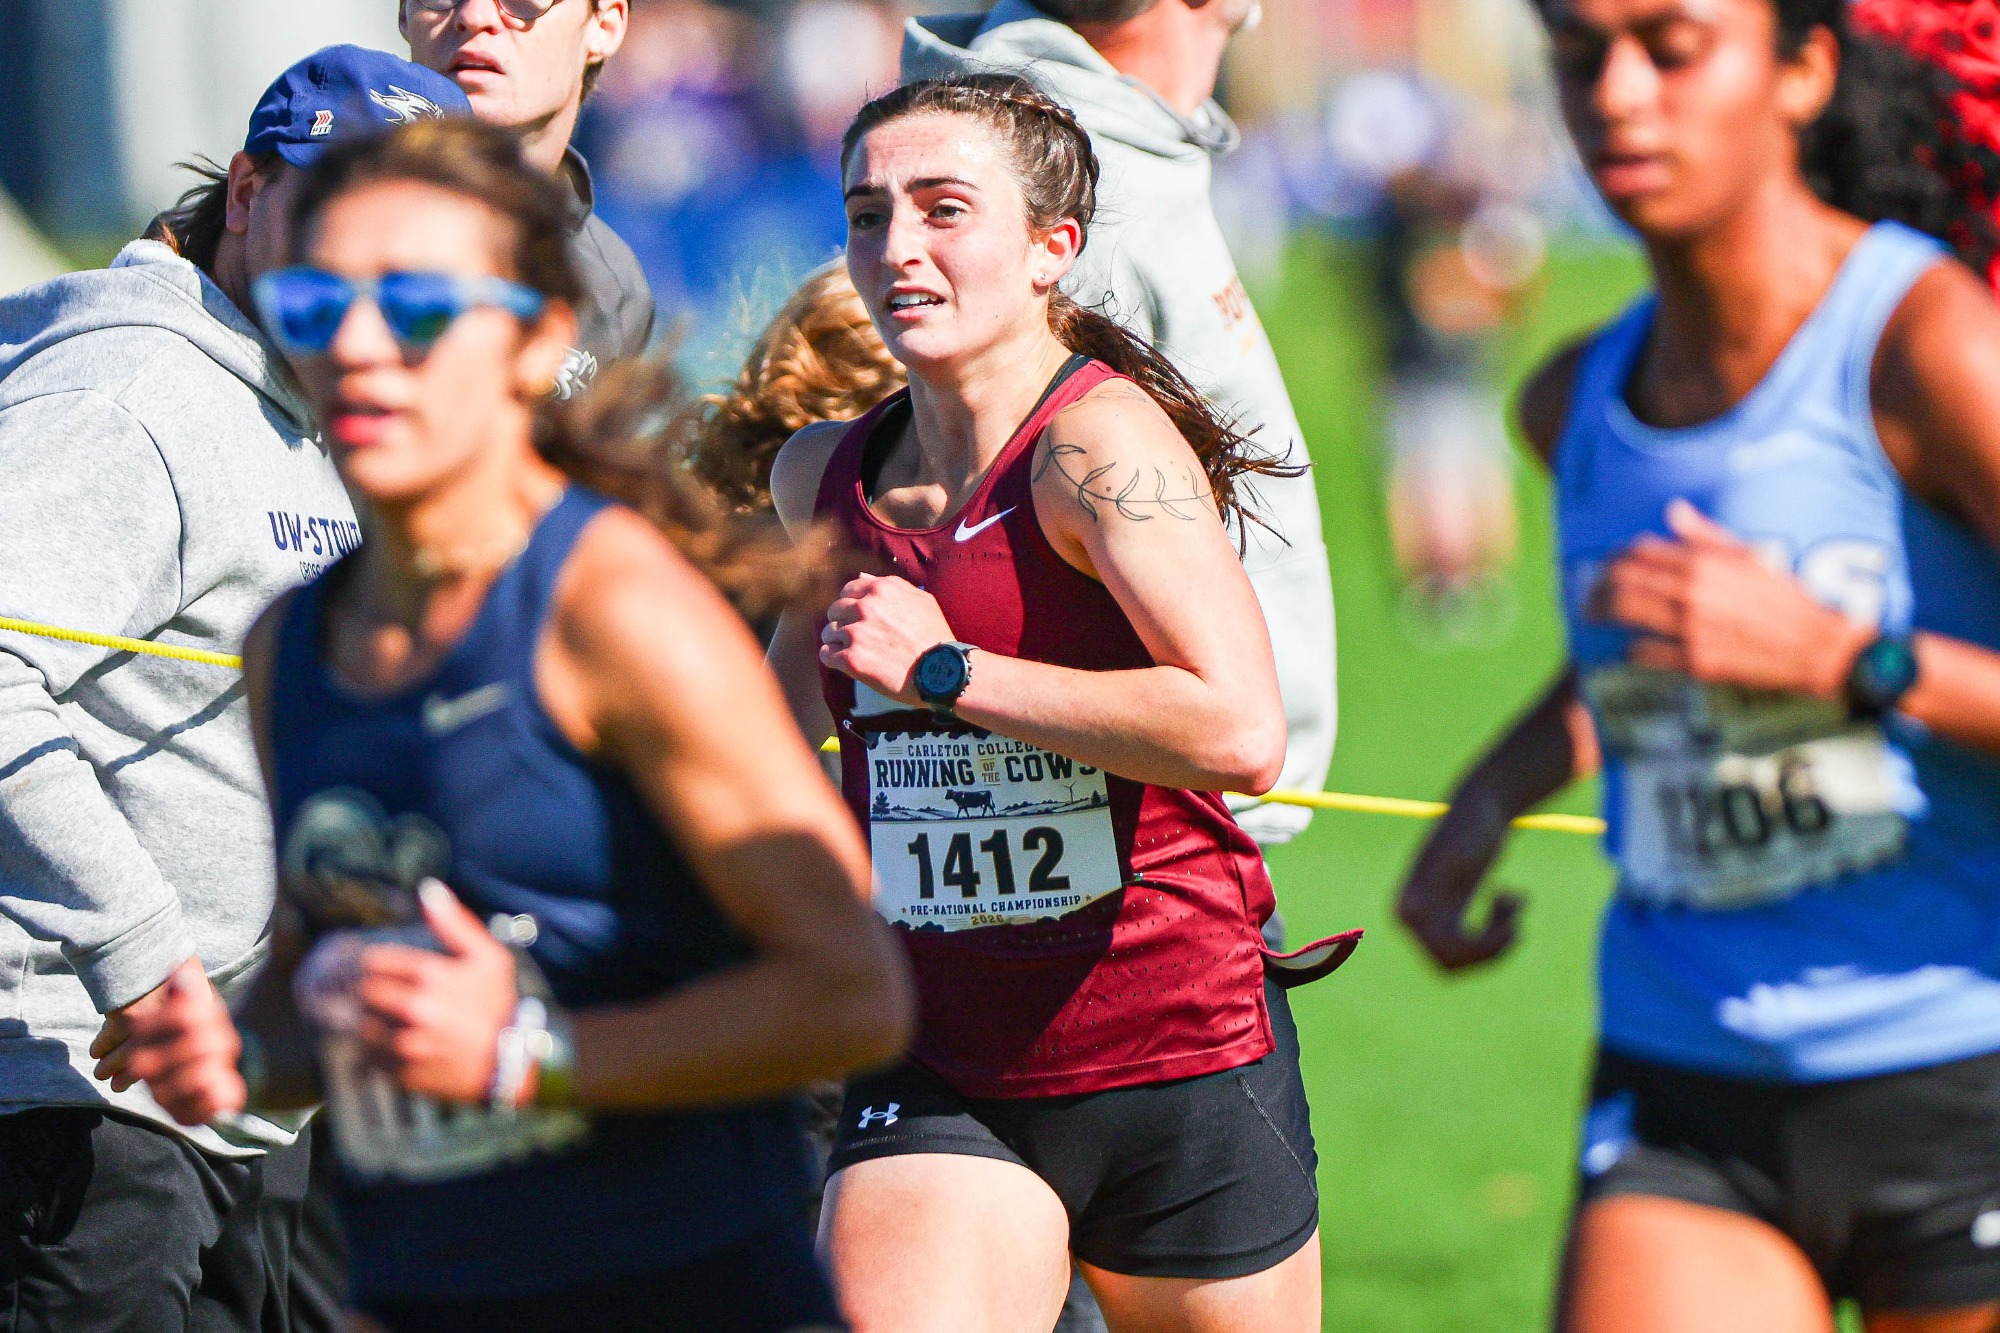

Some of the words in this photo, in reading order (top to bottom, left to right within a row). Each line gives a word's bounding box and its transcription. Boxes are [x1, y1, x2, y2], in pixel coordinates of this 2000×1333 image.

[907, 744, 970, 757] CARLETON
[977, 741, 1042, 756] COLLEG
[875, 758, 976, 788] RUNNING
[983, 762, 995, 771] OF
[982, 772, 1000, 783] THE
[907, 826, 1071, 899] 1412
[910, 902, 987, 916] PRE-NATIONAL
[991, 895, 1082, 913] CHAMPIONSHIP
